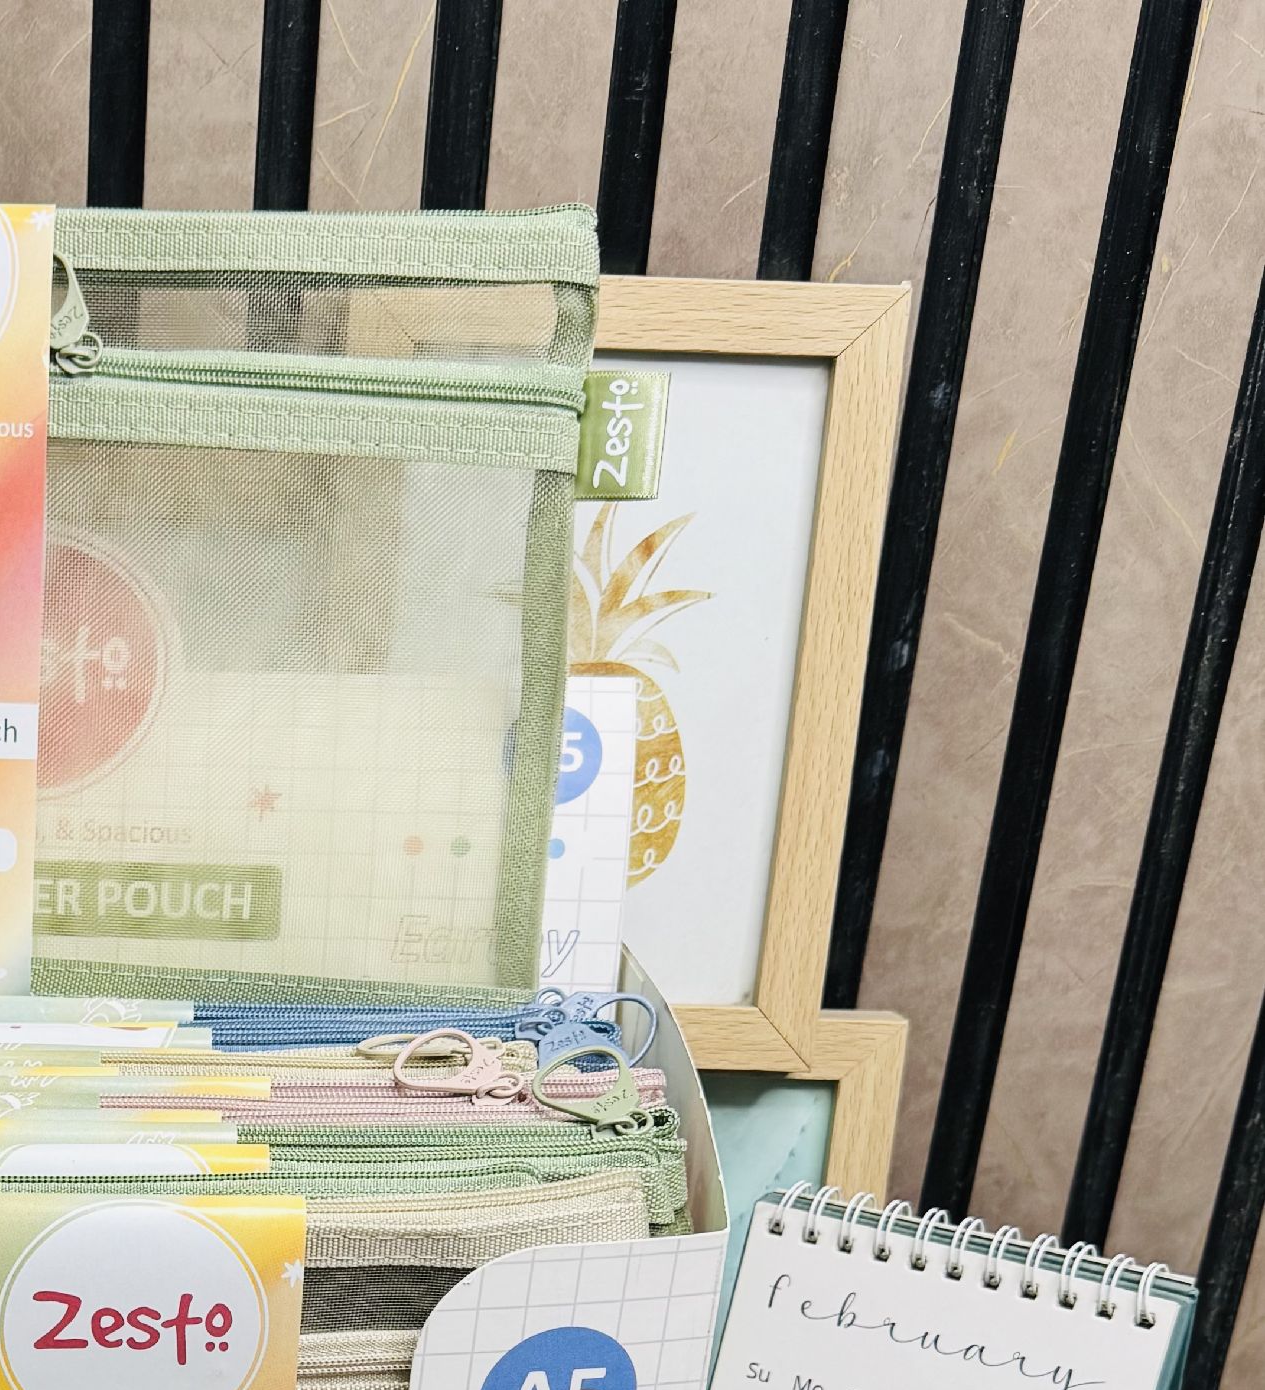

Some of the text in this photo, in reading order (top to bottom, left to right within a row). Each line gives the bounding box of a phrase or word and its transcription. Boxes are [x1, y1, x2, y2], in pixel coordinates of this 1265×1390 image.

[592, 379, 645, 489] Zesto
[97, 878, 253, 921] POUCH
[33, 1290, 233, 1366] Zesto
[747, 1363, 770, 1382] Su
